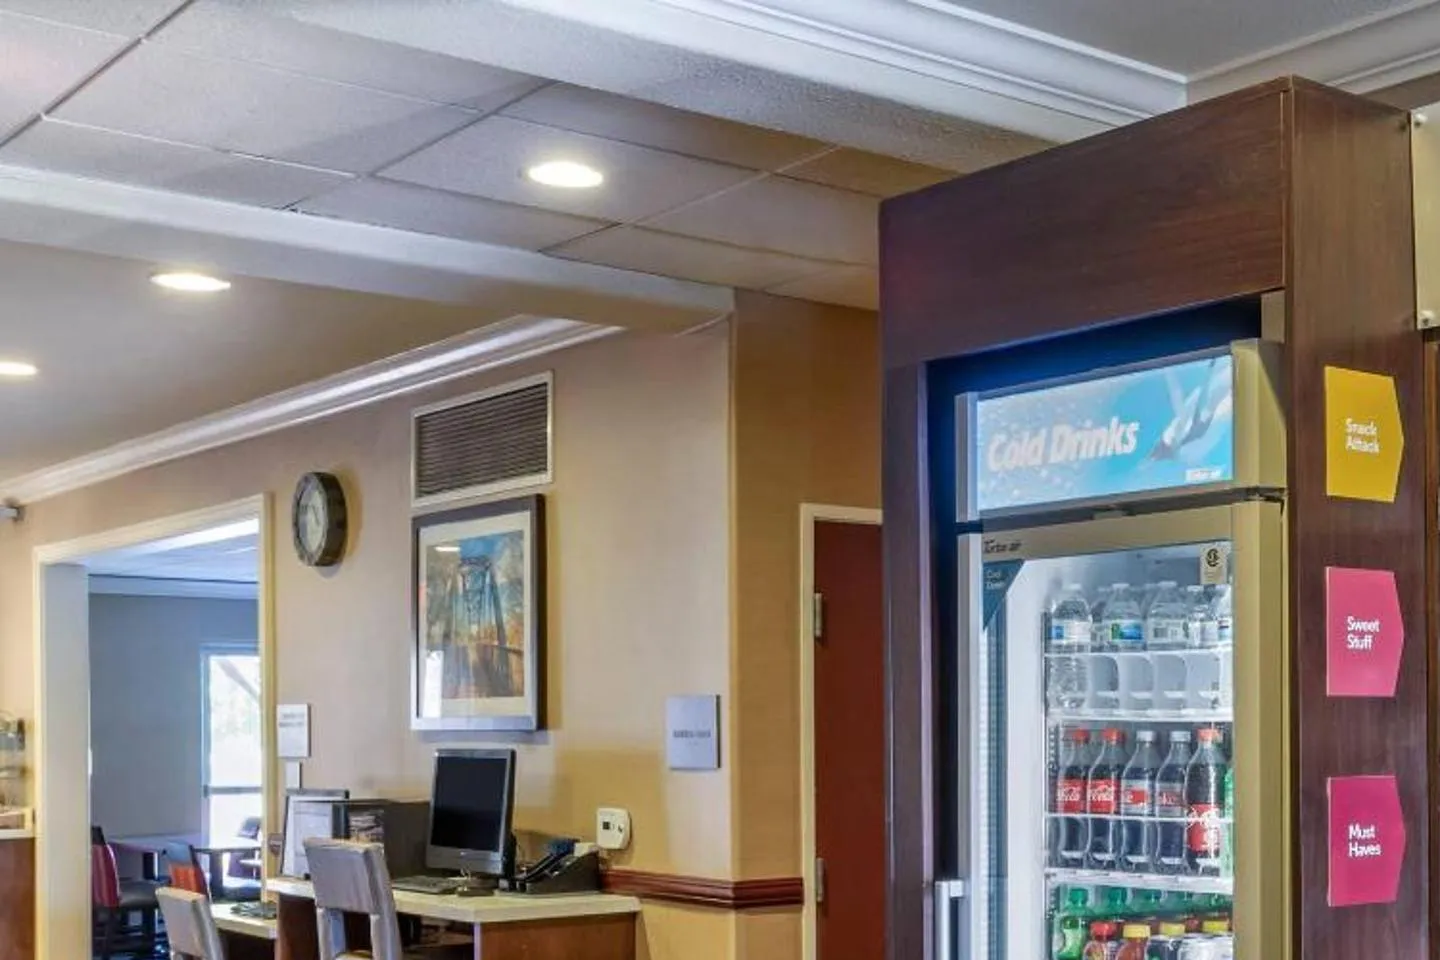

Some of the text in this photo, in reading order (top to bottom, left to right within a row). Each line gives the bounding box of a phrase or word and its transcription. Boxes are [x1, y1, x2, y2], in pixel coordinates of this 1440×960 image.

[1345, 417, 1377, 434] Snack
[987, 415, 1140, 472] Cold Drinks
[1346, 436, 1380, 453] Attack
[1347, 616, 1380, 633] Sweet
[1347, 634, 1373, 651] Stuff
[1349, 824, 1376, 840] Must
[1349, 841, 1381, 857] Haves
